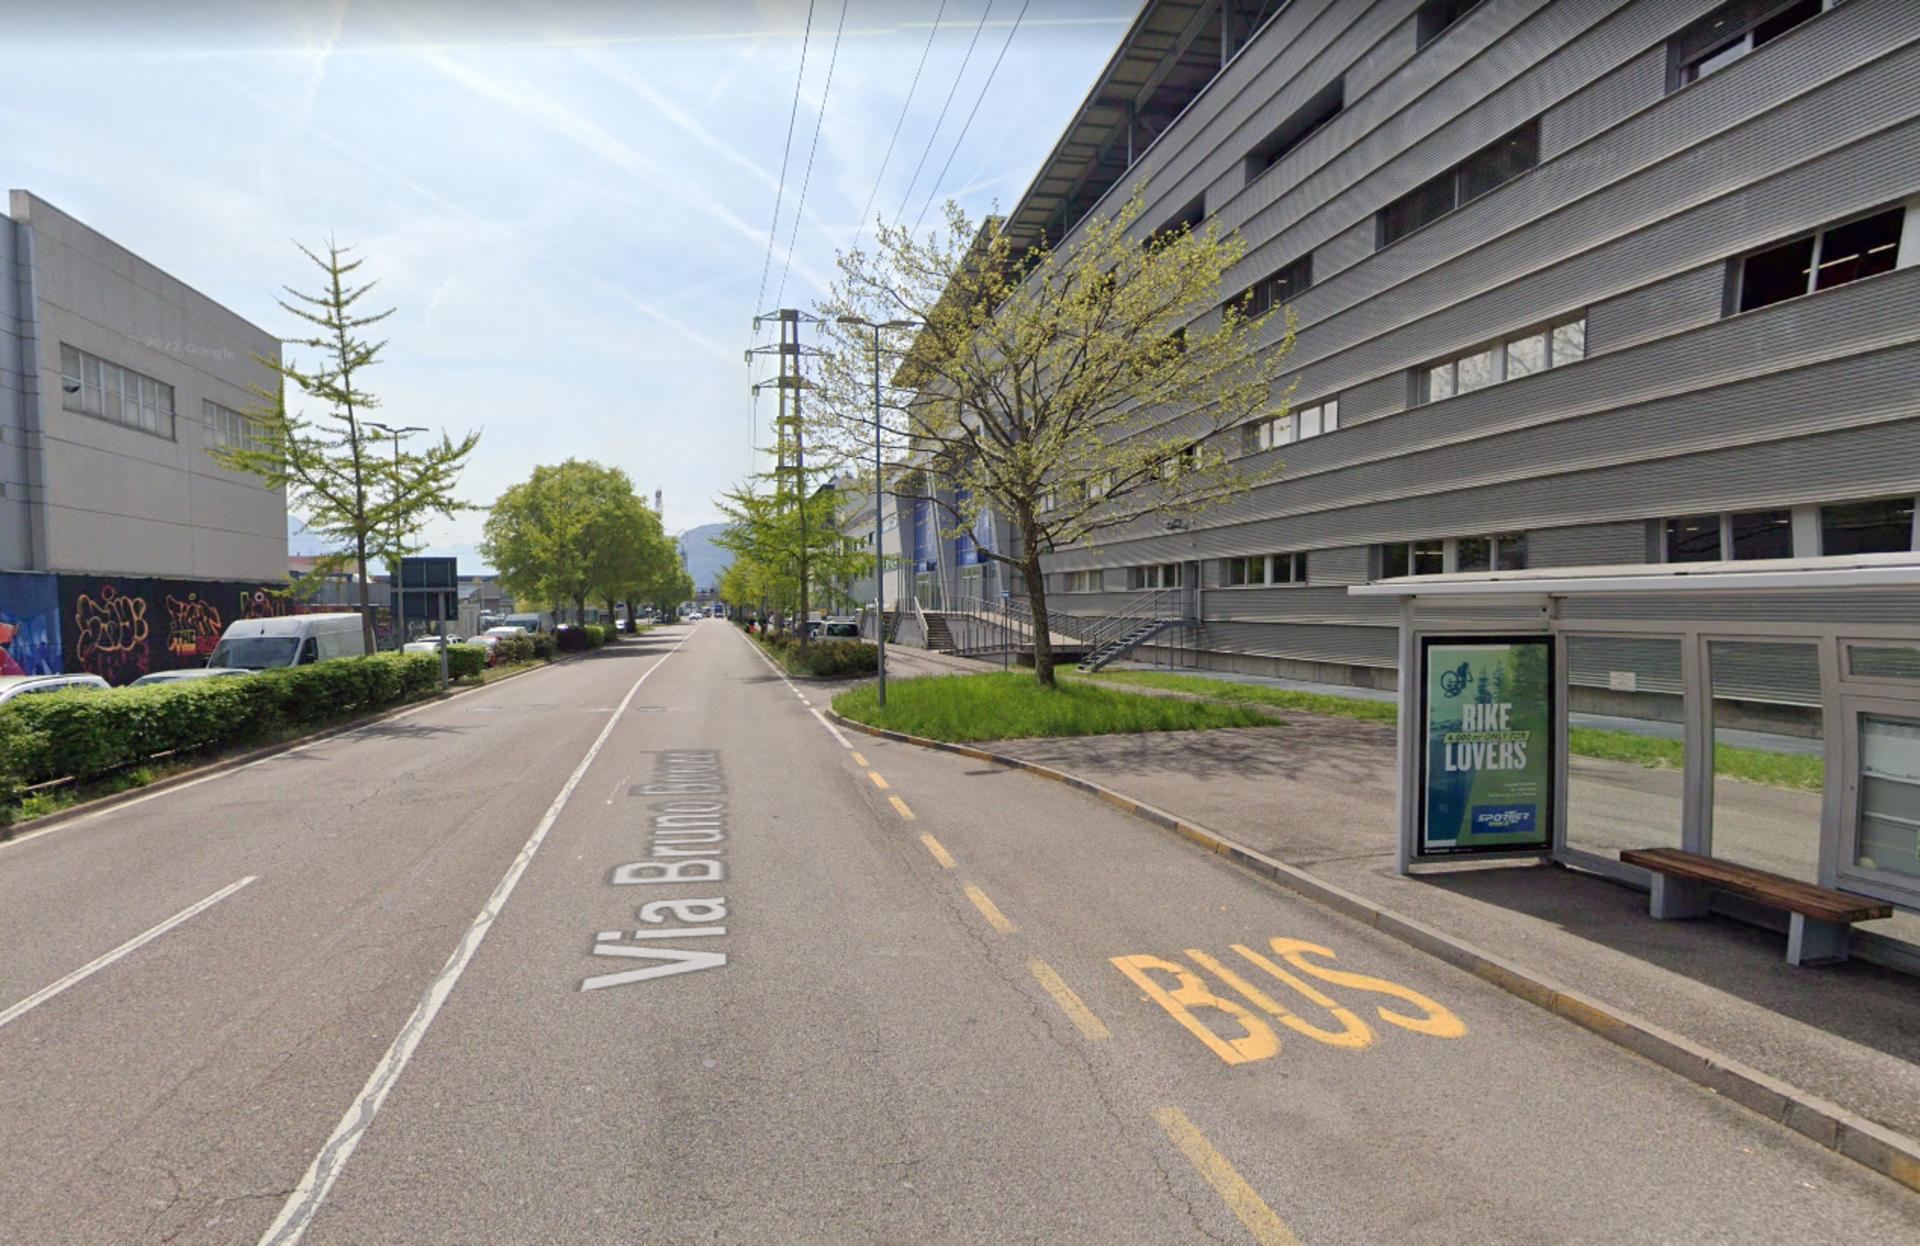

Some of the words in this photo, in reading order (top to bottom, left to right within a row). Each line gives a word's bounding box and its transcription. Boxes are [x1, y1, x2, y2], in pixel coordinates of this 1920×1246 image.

[1462, 703, 1512, 732] BIKE
[1445, 740, 1528, 772] LOVERS
[1109, 936, 1468, 1066] BUS
